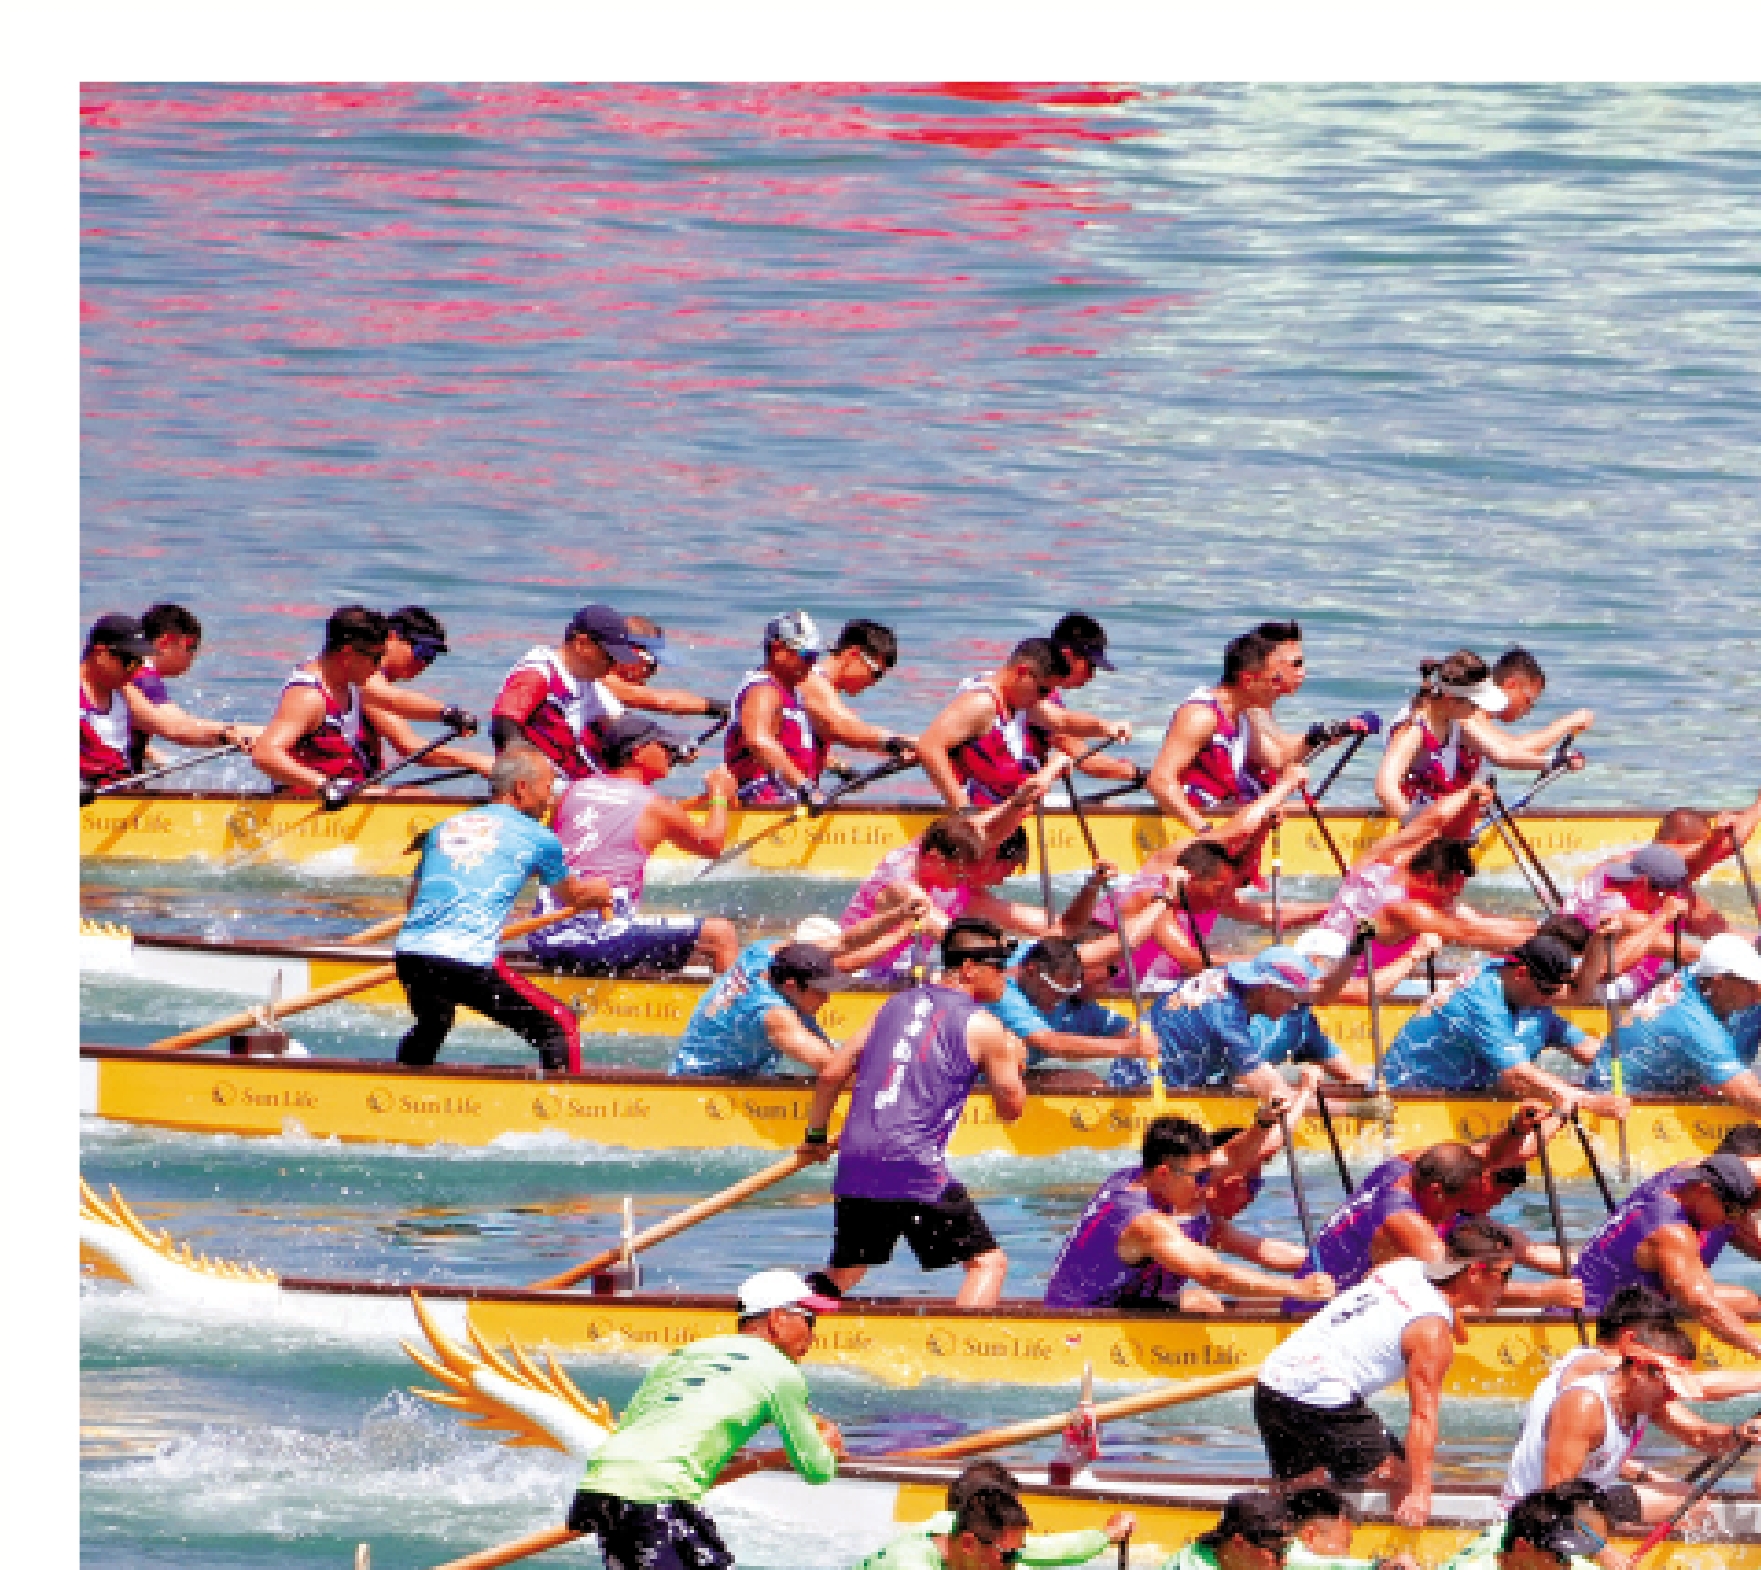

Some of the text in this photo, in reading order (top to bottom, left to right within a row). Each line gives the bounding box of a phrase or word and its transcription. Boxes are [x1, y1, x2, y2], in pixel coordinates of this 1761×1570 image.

[241, 1089, 318, 1109] Sun Life
[399, 1095, 482, 1117] Sun Life
[567, 1098, 651, 1120] Sun Life
[963, 1337, 1008, 1357] Sun
